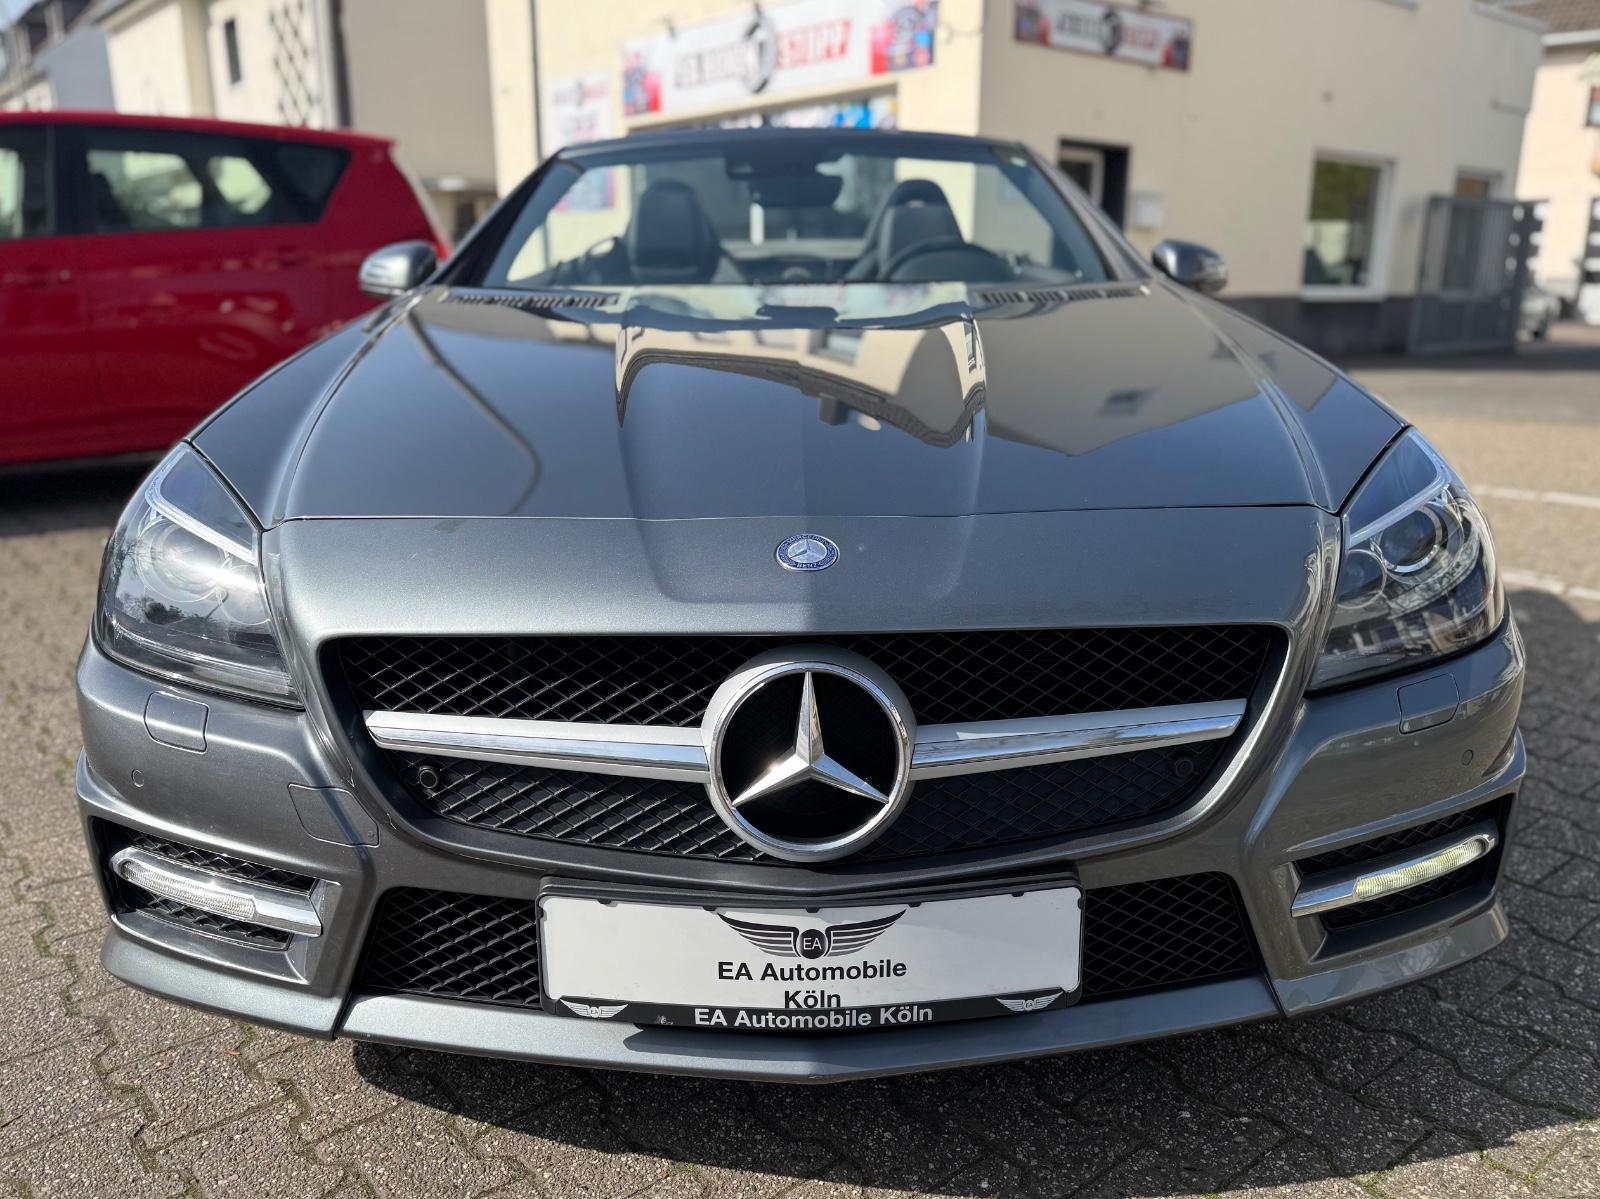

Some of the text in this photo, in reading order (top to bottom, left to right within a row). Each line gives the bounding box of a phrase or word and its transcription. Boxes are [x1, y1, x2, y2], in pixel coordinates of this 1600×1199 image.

[803, 938, 822, 950] EA
[718, 959, 907, 981] EA Automobile
[784, 990, 841, 1009] Köln
[694, 1005, 933, 1028] EA Automobile Köln
